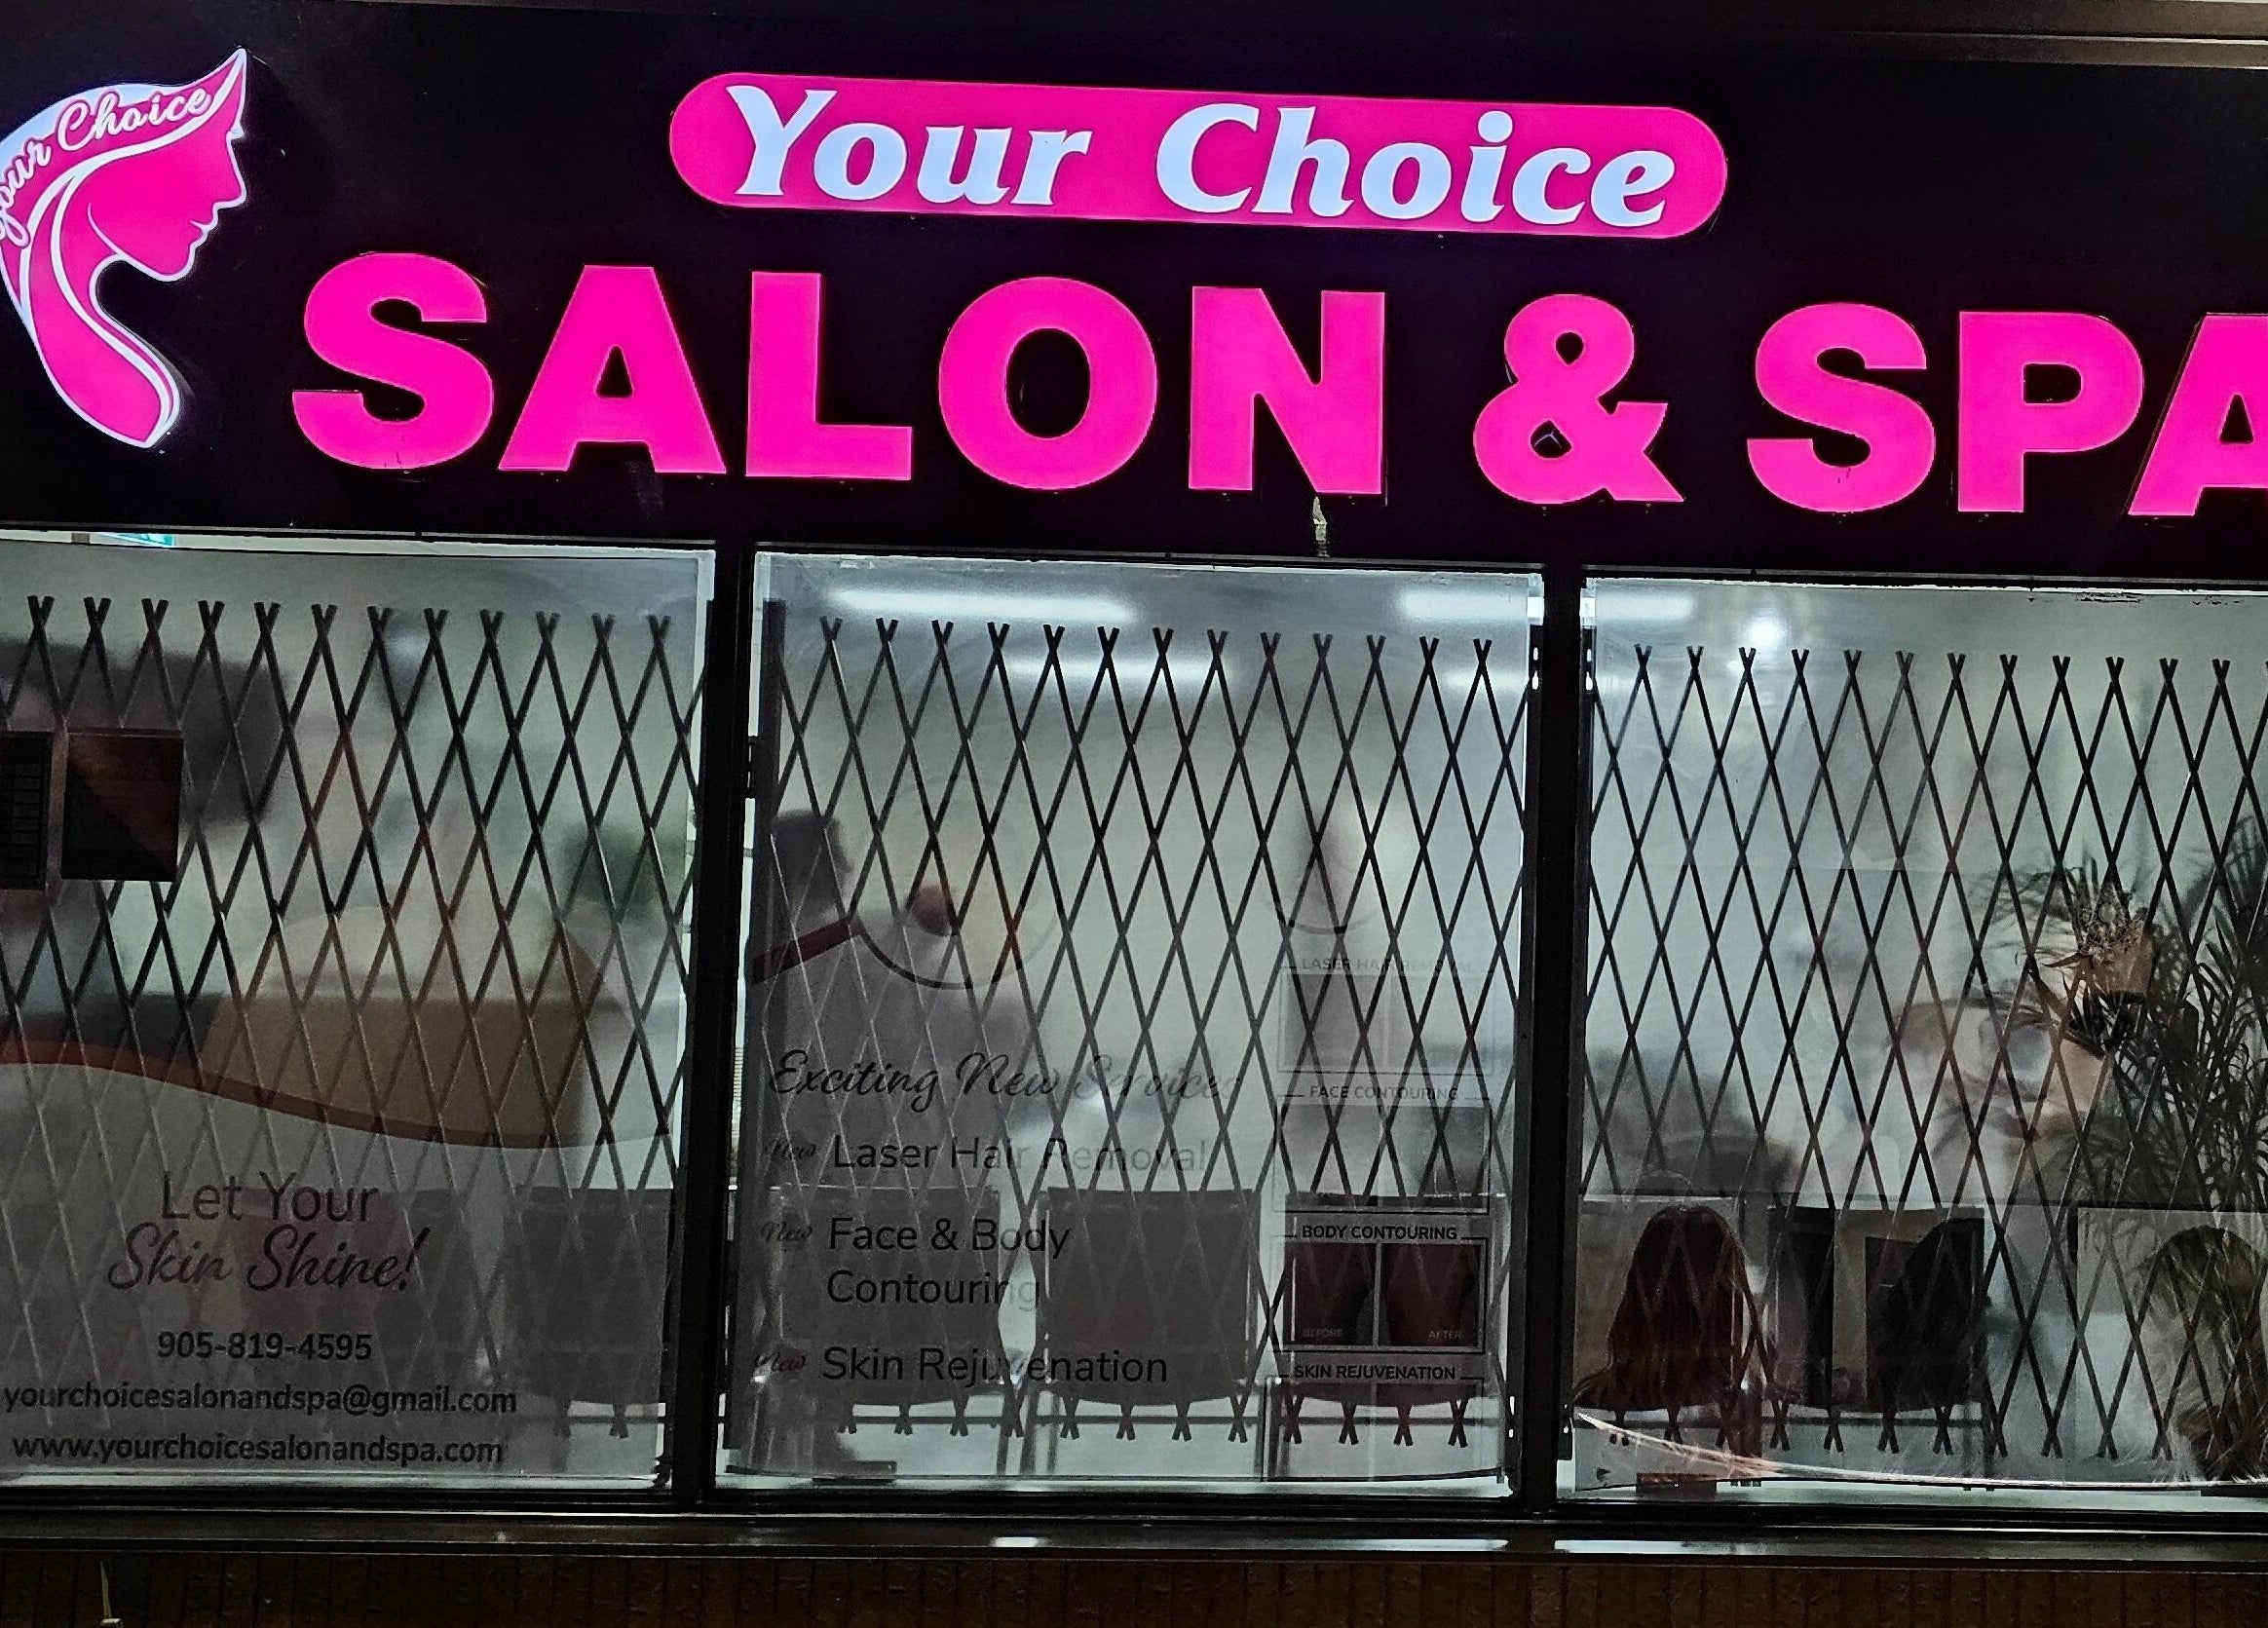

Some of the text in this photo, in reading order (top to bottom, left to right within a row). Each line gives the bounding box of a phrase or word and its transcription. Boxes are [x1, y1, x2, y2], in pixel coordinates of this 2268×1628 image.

[57, 87, 213, 150] Choice
[727, 85, 1676, 229] Your Choice
[291, 252, 2268, 516] SALON & SPA
[771, 1049, 939, 1113] Exciting
[955, 1052, 1057, 1097] New
[1310, 1084, 1349, 1099] FACE
[833, 1135, 936, 1169] Laser
[951, 1136, 1031, 1169] Hair
[162, 1171, 379, 1223] Let Your
[829, 1218, 917, 1251] Face
[930, 1218, 960, 1251] &
[971, 1218, 1070, 1260] Body
[1302, 1224, 1458, 1241] BODY CONTOURING
[108, 1221, 431, 1293] Skin Shine!
[826, 1271, 1040, 1312] Contouring
[157, 1331, 372, 1361] 905-819-4595
[822, 1346, 903, 1380] Skin
[920, 1347, 1167, 1389] Rejuvenation
[1294, 1364, 1455, 1381] SKIN REJUVENATION
[3, 1382, 517, 1417] yourchoicesalonandspa@gmail.com
[12, 1432, 504, 1467] www.yourchoicesalonandspa.com
